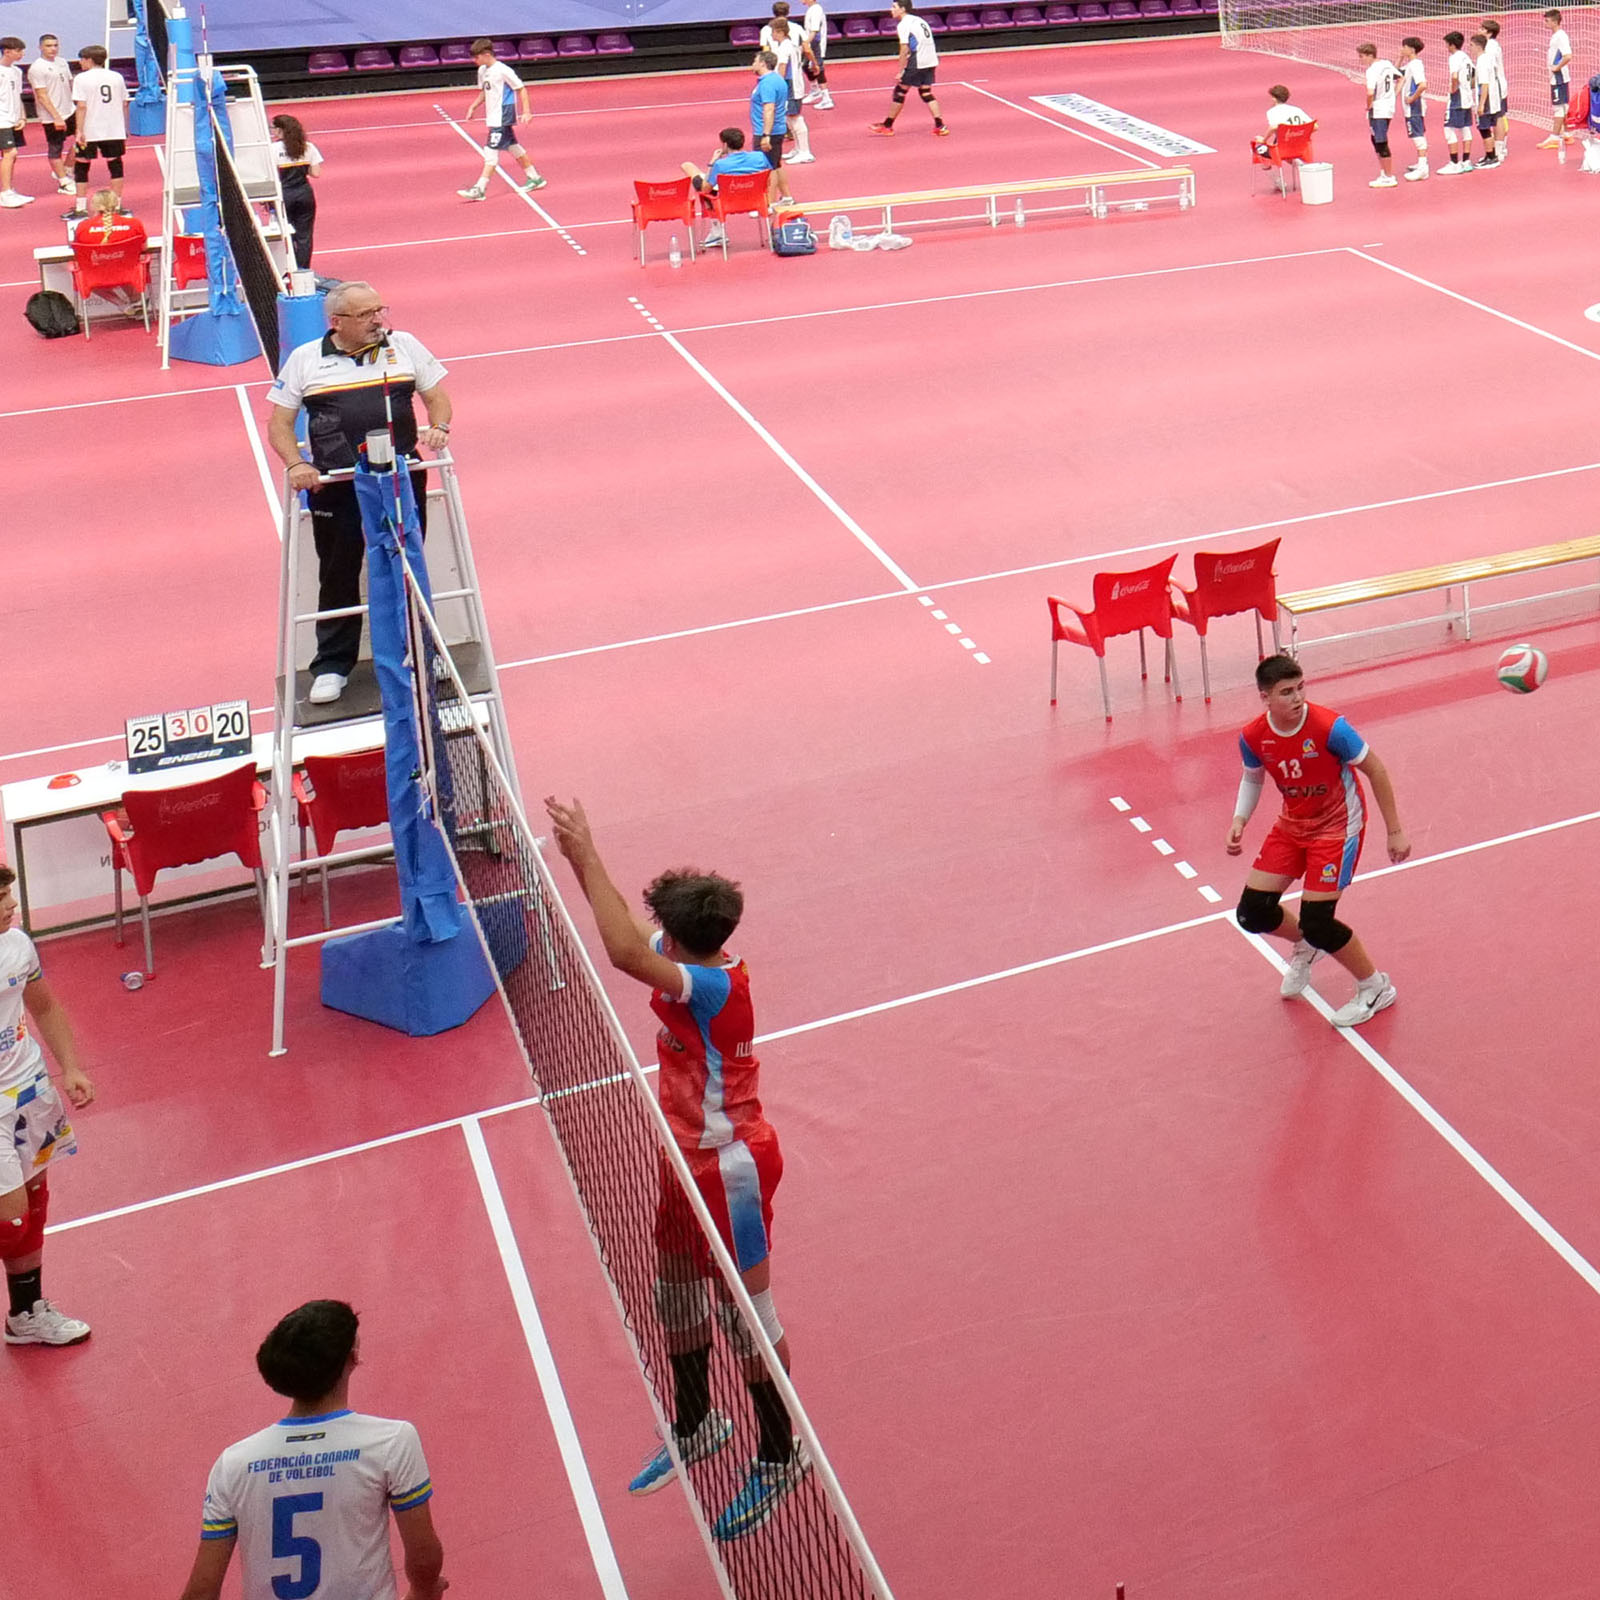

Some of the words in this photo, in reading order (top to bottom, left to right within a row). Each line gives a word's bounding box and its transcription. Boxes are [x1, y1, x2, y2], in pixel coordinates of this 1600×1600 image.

[922, 23, 930, 39] 8
[100, 84, 112, 103] 9
[1384, 72, 1391, 94] 6
[132, 724, 162, 754] 25
[171, 718, 187, 738] 3
[194, 714, 208, 734] 0
[216, 710, 244, 739] 20
[1277, 758, 1303, 780] 13
[248, 1451, 312, 1474] FEDERACIÓN
[314, 1448, 361, 1466] CANARIA
[268, 1471, 282, 1483] DE
[285, 1464, 336, 1482] VOLEIBOL
[271, 1491, 324, 1600] 5
